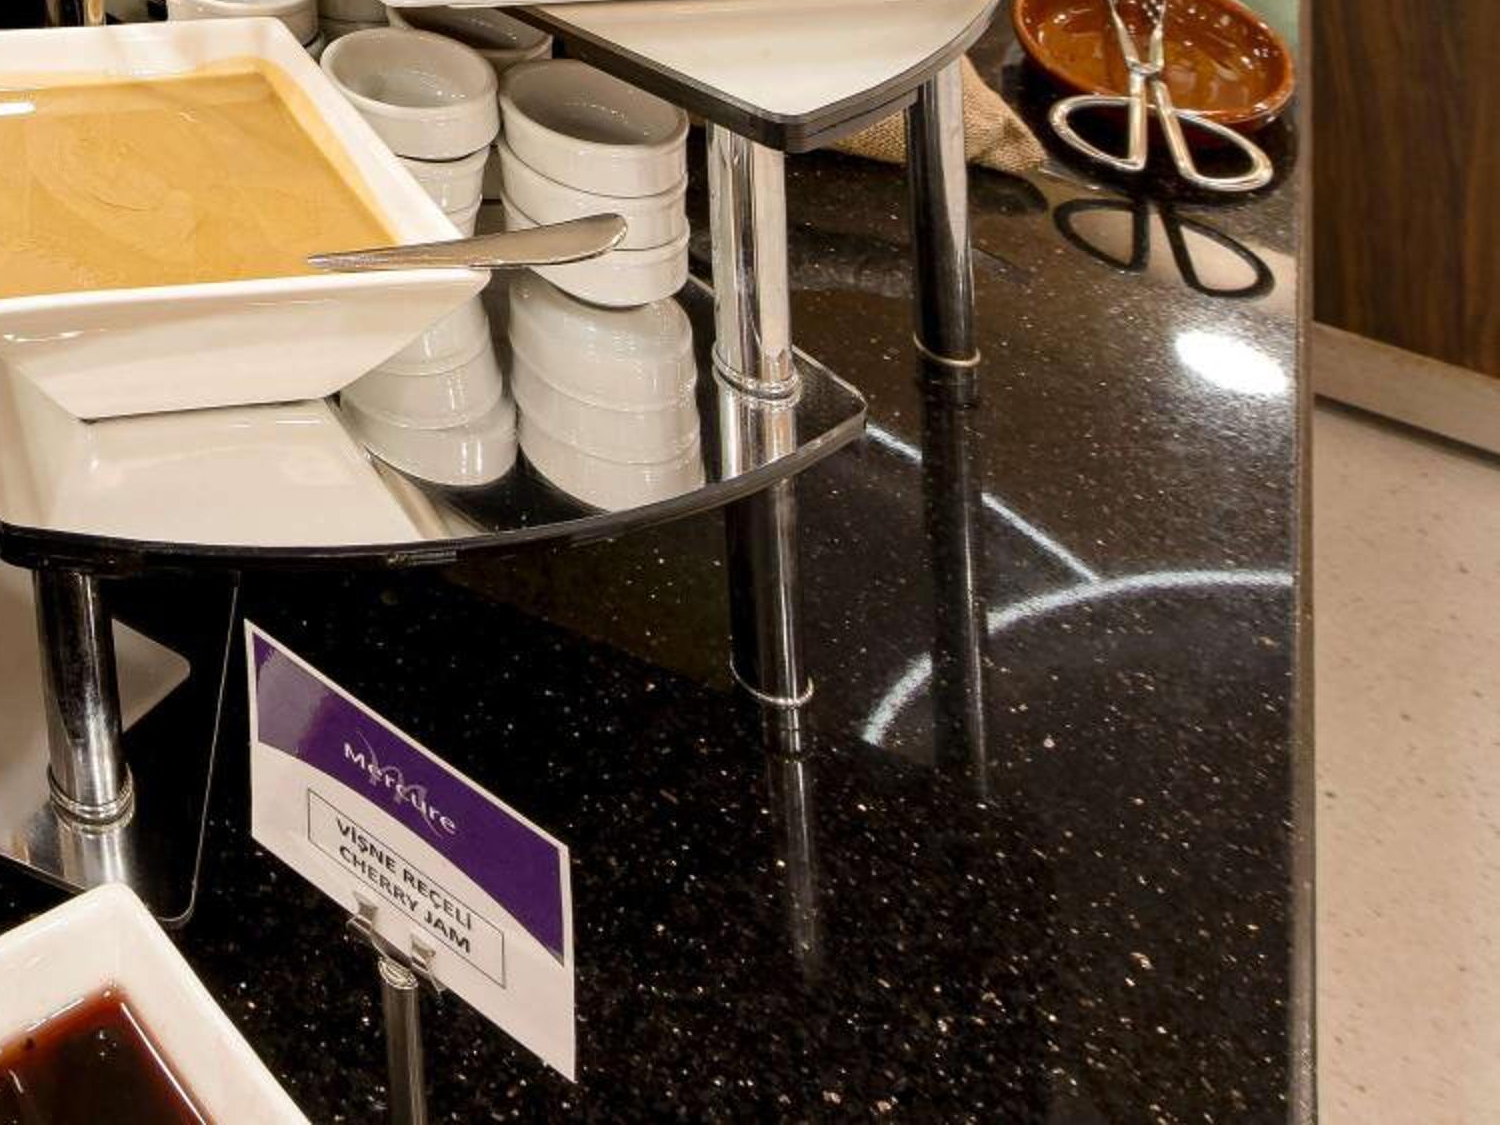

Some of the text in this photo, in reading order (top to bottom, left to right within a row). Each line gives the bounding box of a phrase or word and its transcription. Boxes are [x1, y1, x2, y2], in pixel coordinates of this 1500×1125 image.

[343, 741, 457, 836] Mercure
[335, 815, 473, 931] VİŞNE REÇELİ
[338, 844, 471, 954] CHERRY JAM
